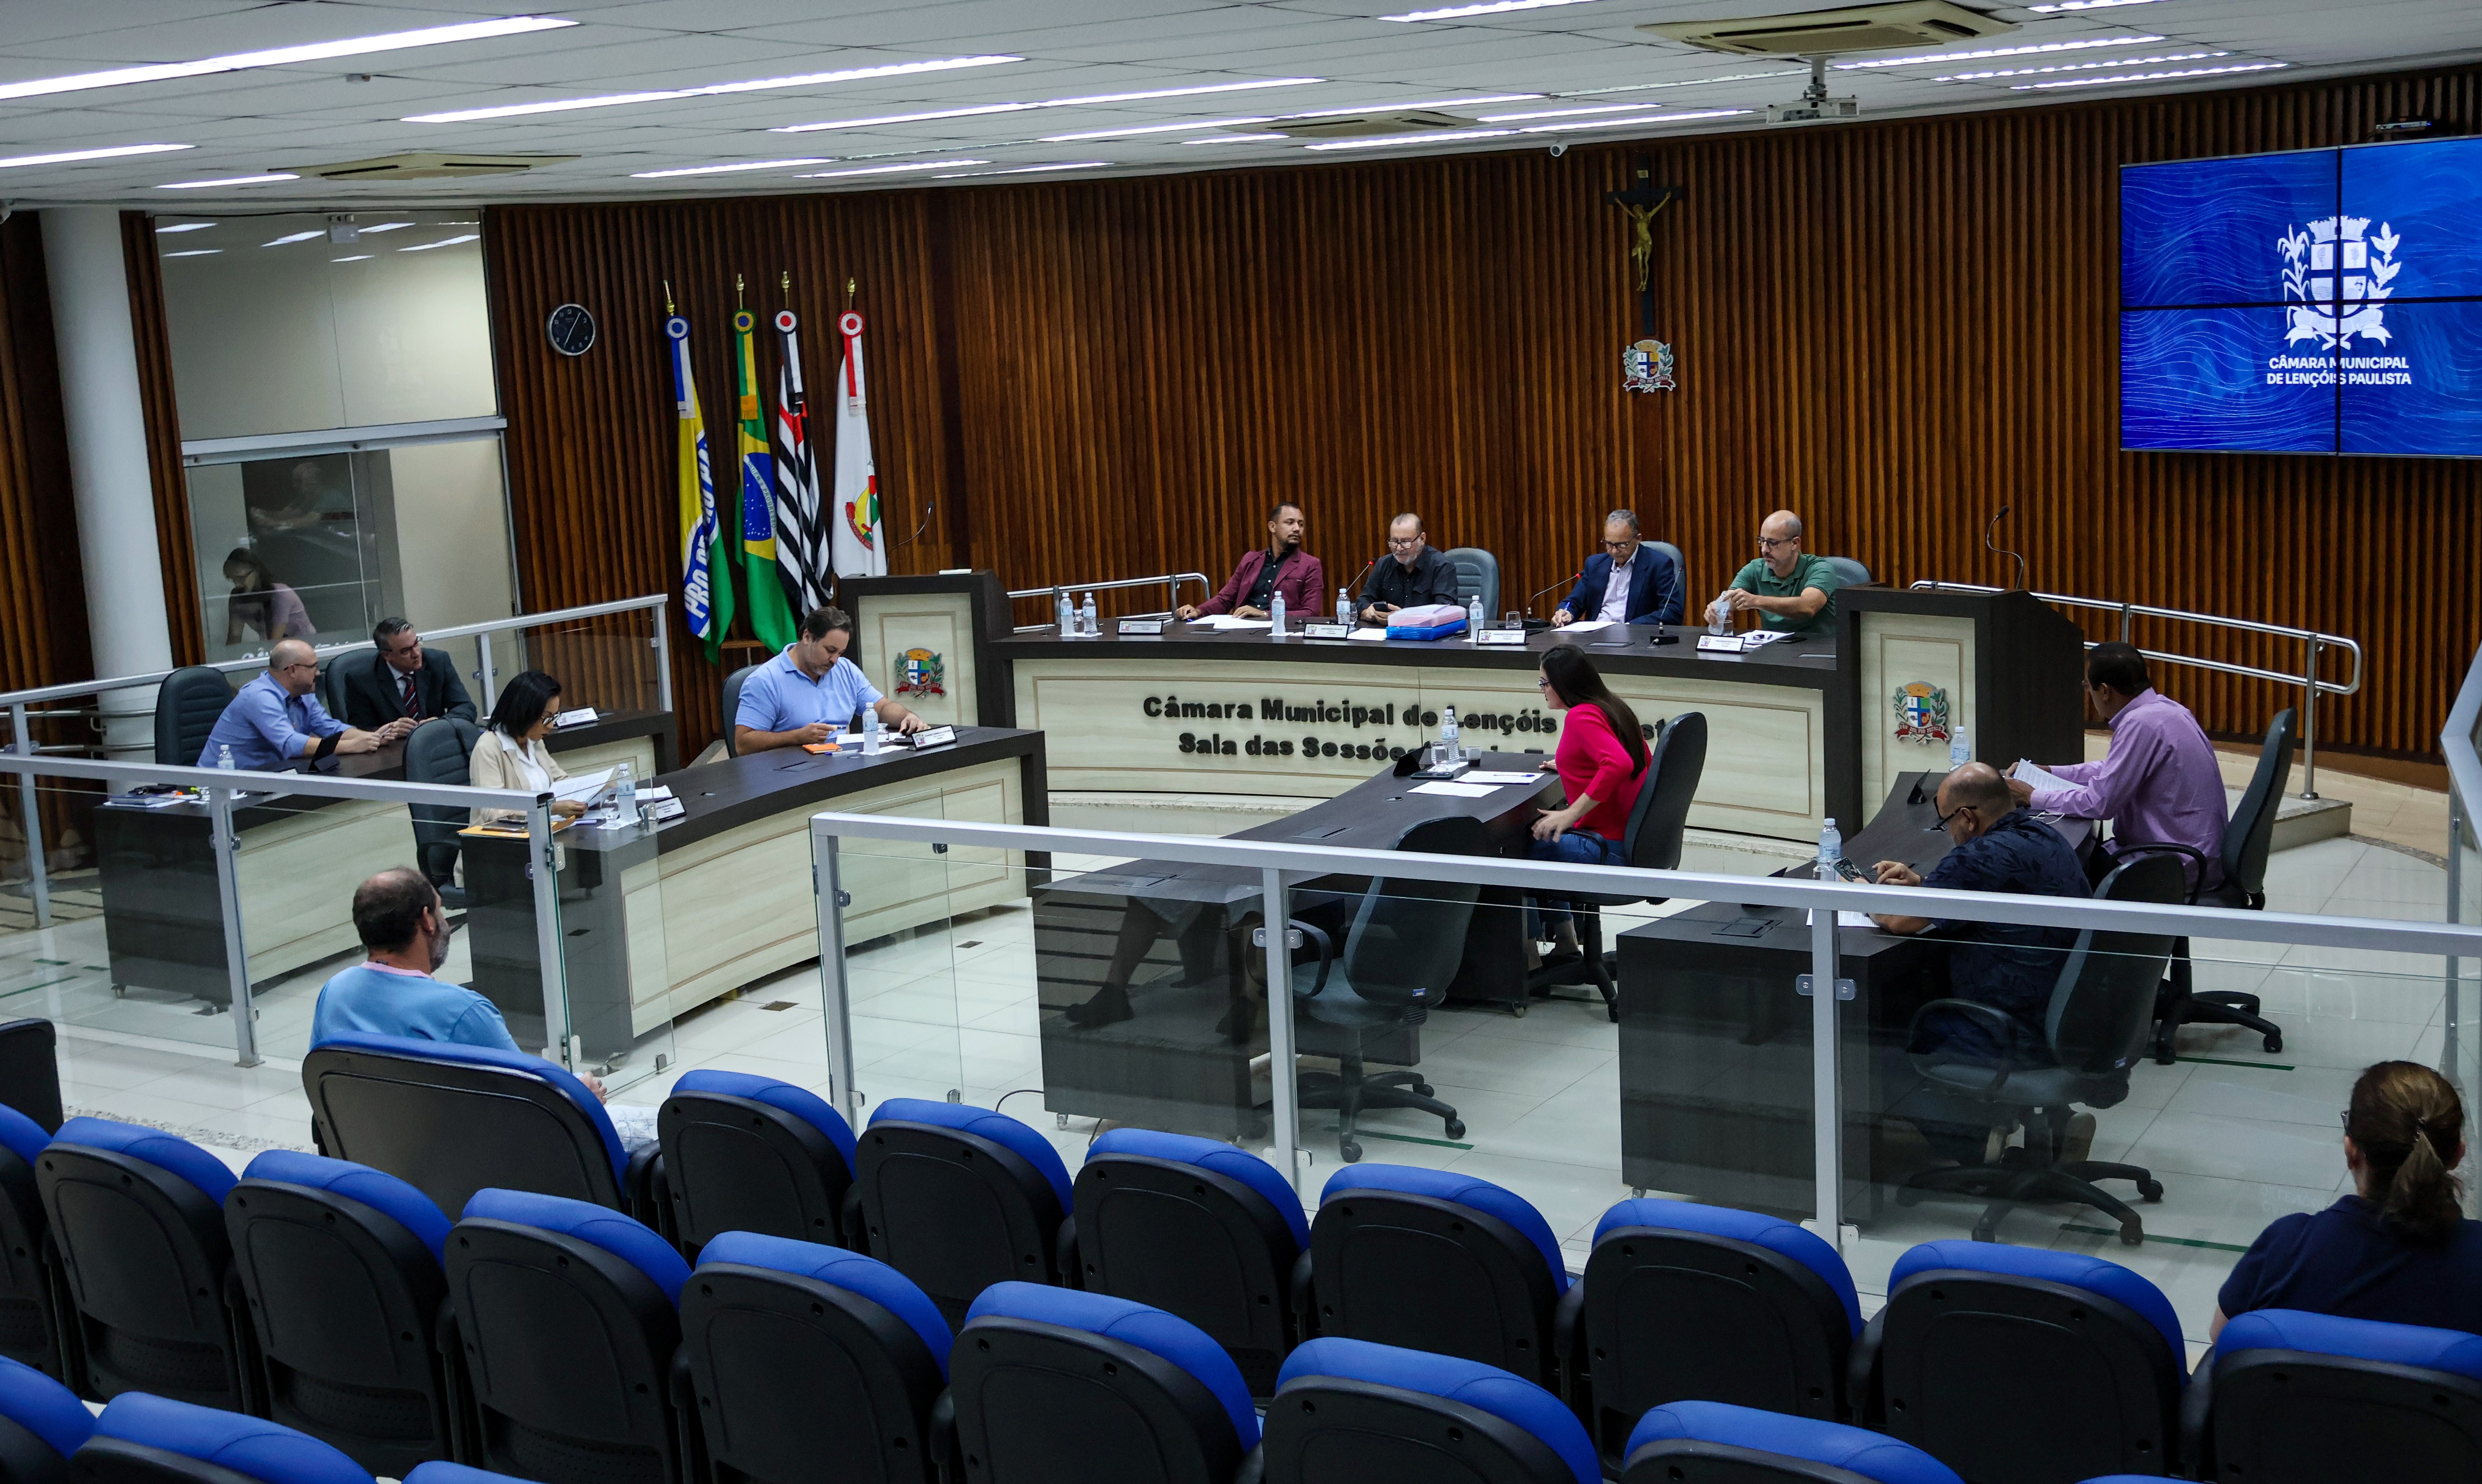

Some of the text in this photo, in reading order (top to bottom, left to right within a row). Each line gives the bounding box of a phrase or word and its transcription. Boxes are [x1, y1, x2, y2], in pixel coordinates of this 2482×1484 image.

[2269, 355, 2409, 369] CÂMARA MUNICIPAL
[2267, 370, 2412, 388] DE LENÇÓIS PAULISTA
[1143, 697, 1253, 719] Câmara
[1261, 699, 1393, 728] Municipal
[1402, 705, 1438, 727] de
[1179, 732, 1418, 762] Sala das Sessõe
